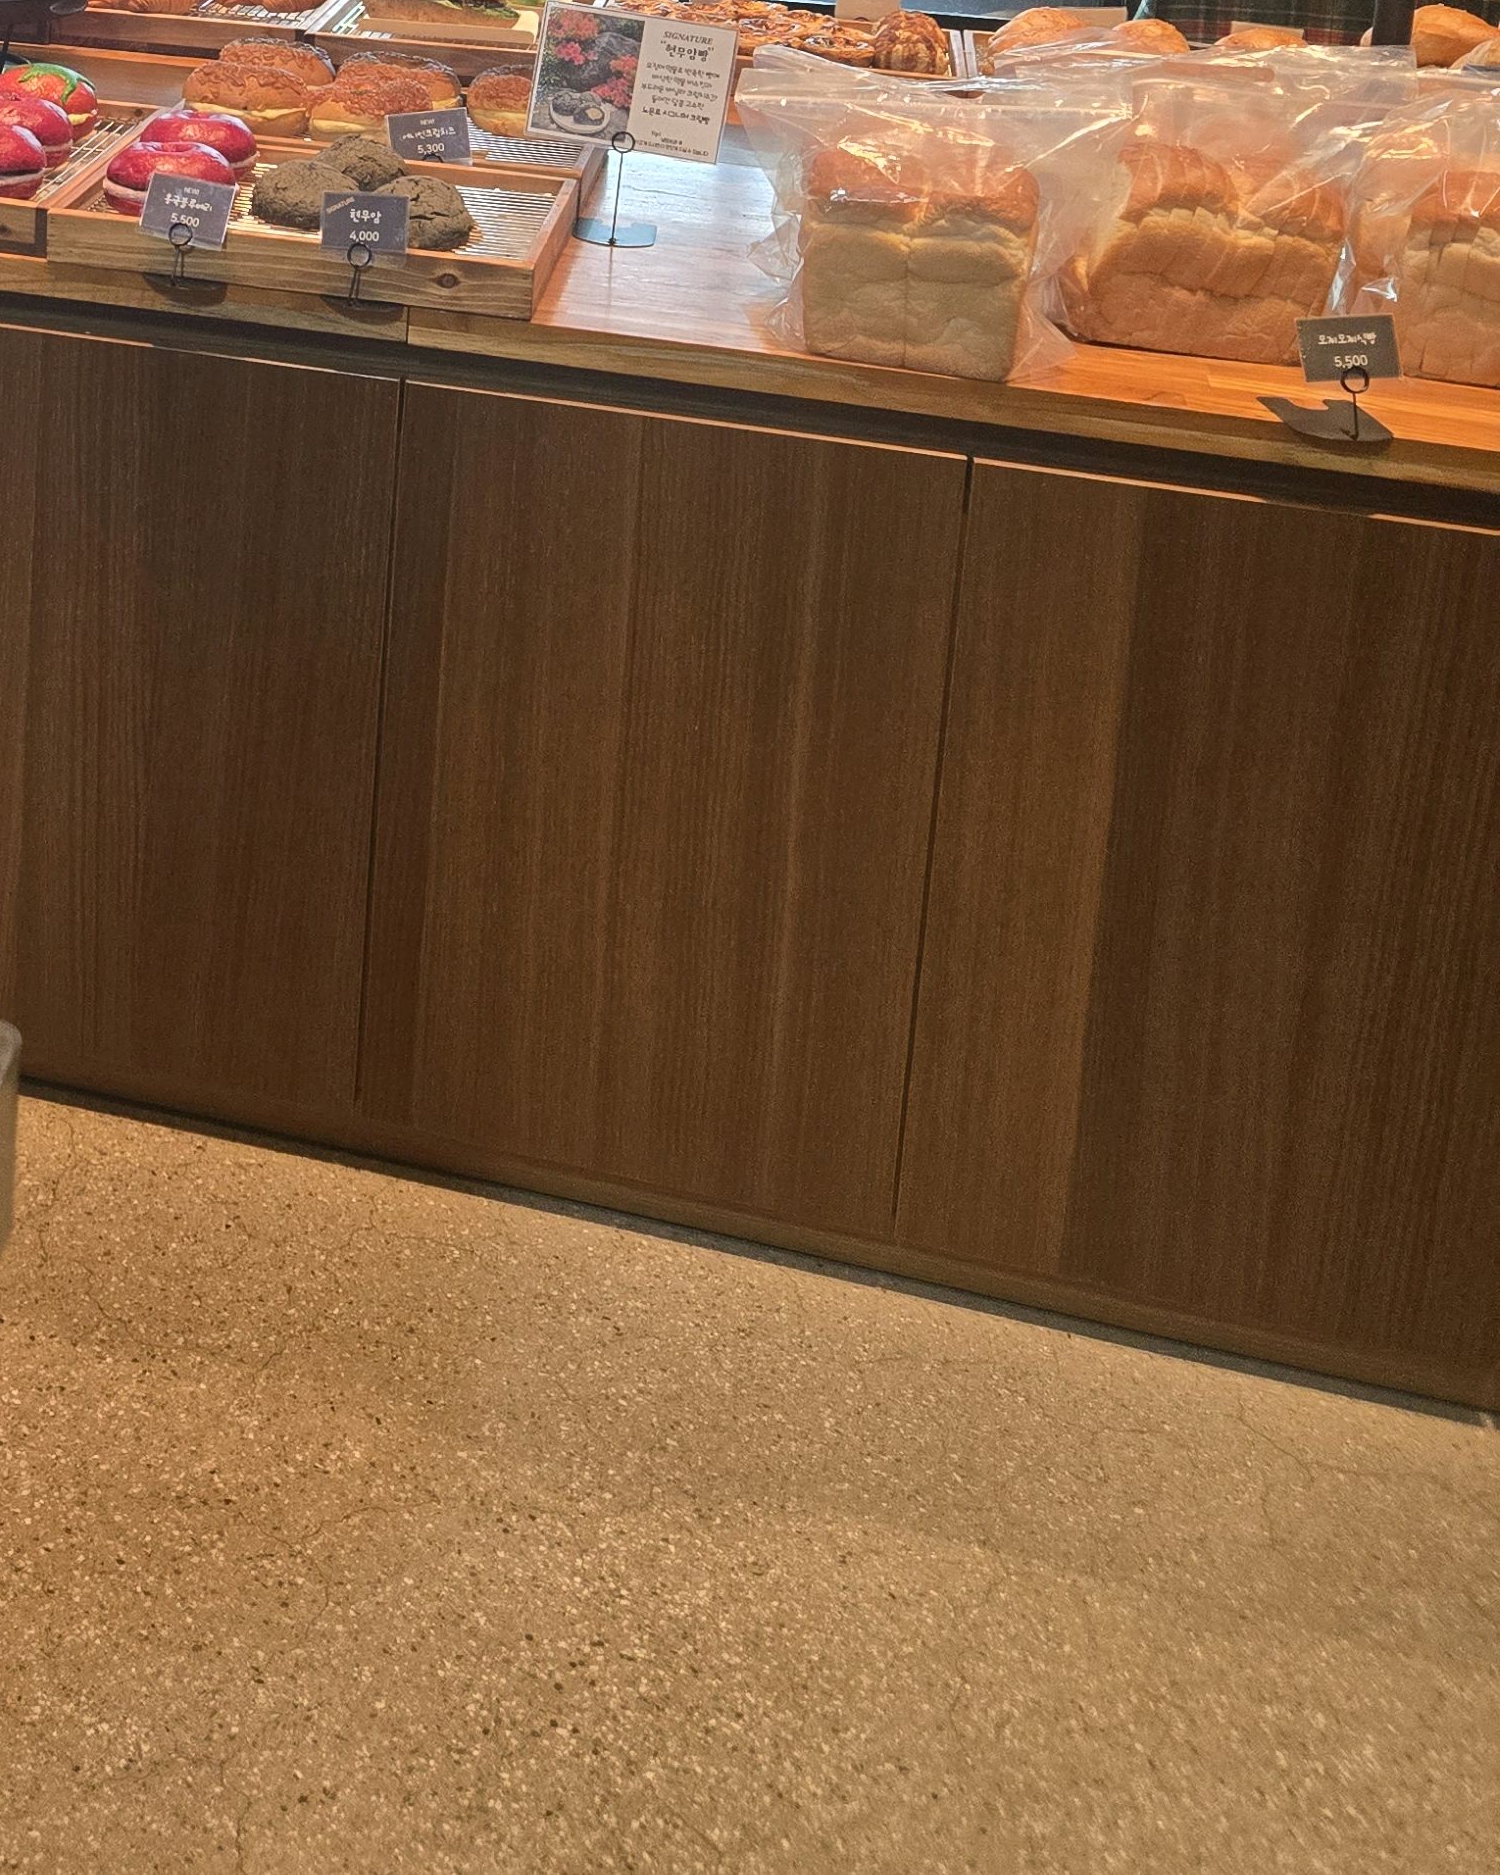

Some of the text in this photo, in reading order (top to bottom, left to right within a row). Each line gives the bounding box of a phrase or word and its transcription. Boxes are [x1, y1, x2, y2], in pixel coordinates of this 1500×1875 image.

[663, 31, 713, 45] SIGNATURE
[417, 143, 445, 155] 5,300
[170, 212, 200, 227] 5,500
[349, 230, 379, 242] 4,000
[1334, 354, 1368, 369] 5,500
